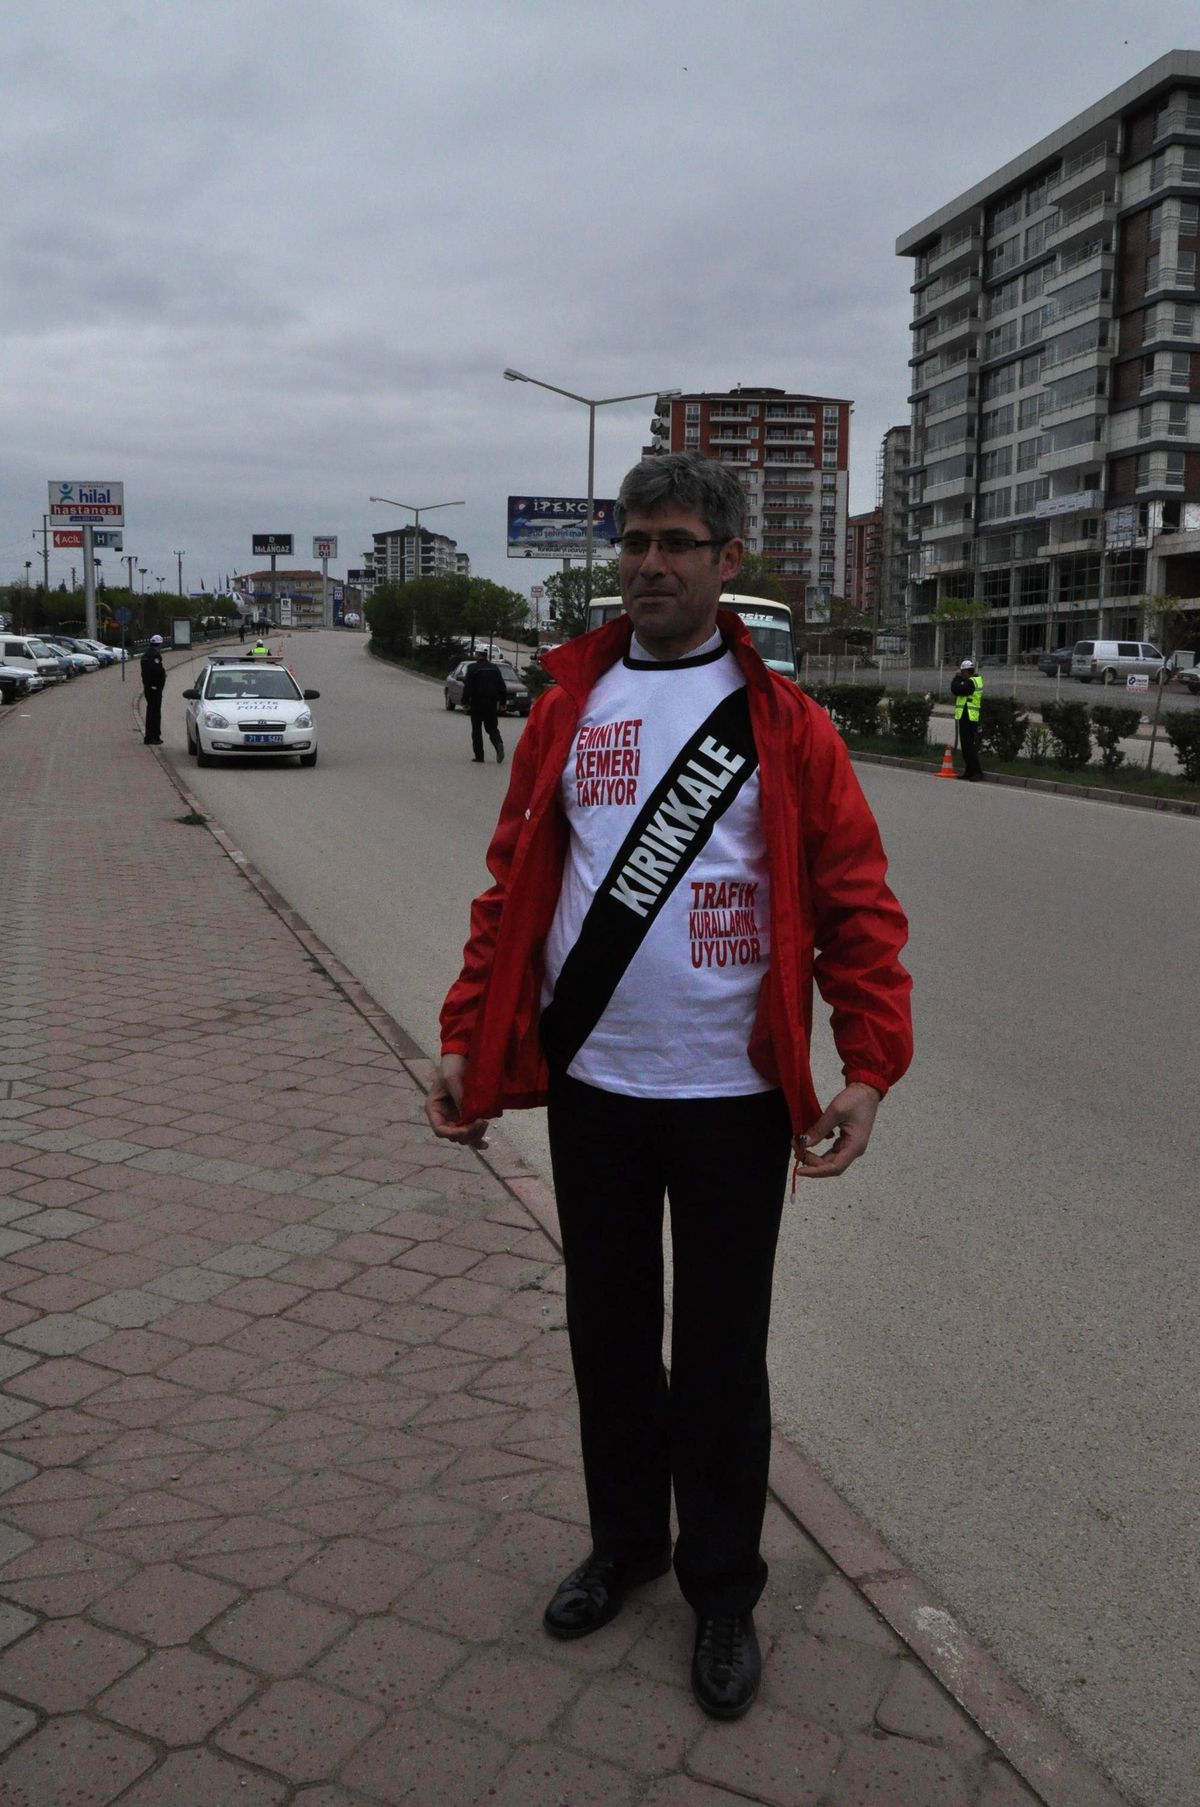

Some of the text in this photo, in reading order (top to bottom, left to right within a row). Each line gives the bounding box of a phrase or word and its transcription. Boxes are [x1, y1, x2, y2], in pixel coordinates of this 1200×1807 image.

[53, 505, 119, 514] hastanesi
[79, 489, 110, 503] hilal
[534, 499, 595, 513] İPEKC
[576, 719, 643, 751] EMNİYET
[575, 749, 641, 779] KEMERİ
[576, 778, 638, 807] TAKIYOR
[609, 735, 747, 918] KIRIKKALE
[690, 882, 759, 910] TRAFİK
[689, 909, 759, 939] KURALLARINA
[690, 937, 761, 968] UYUYOR
